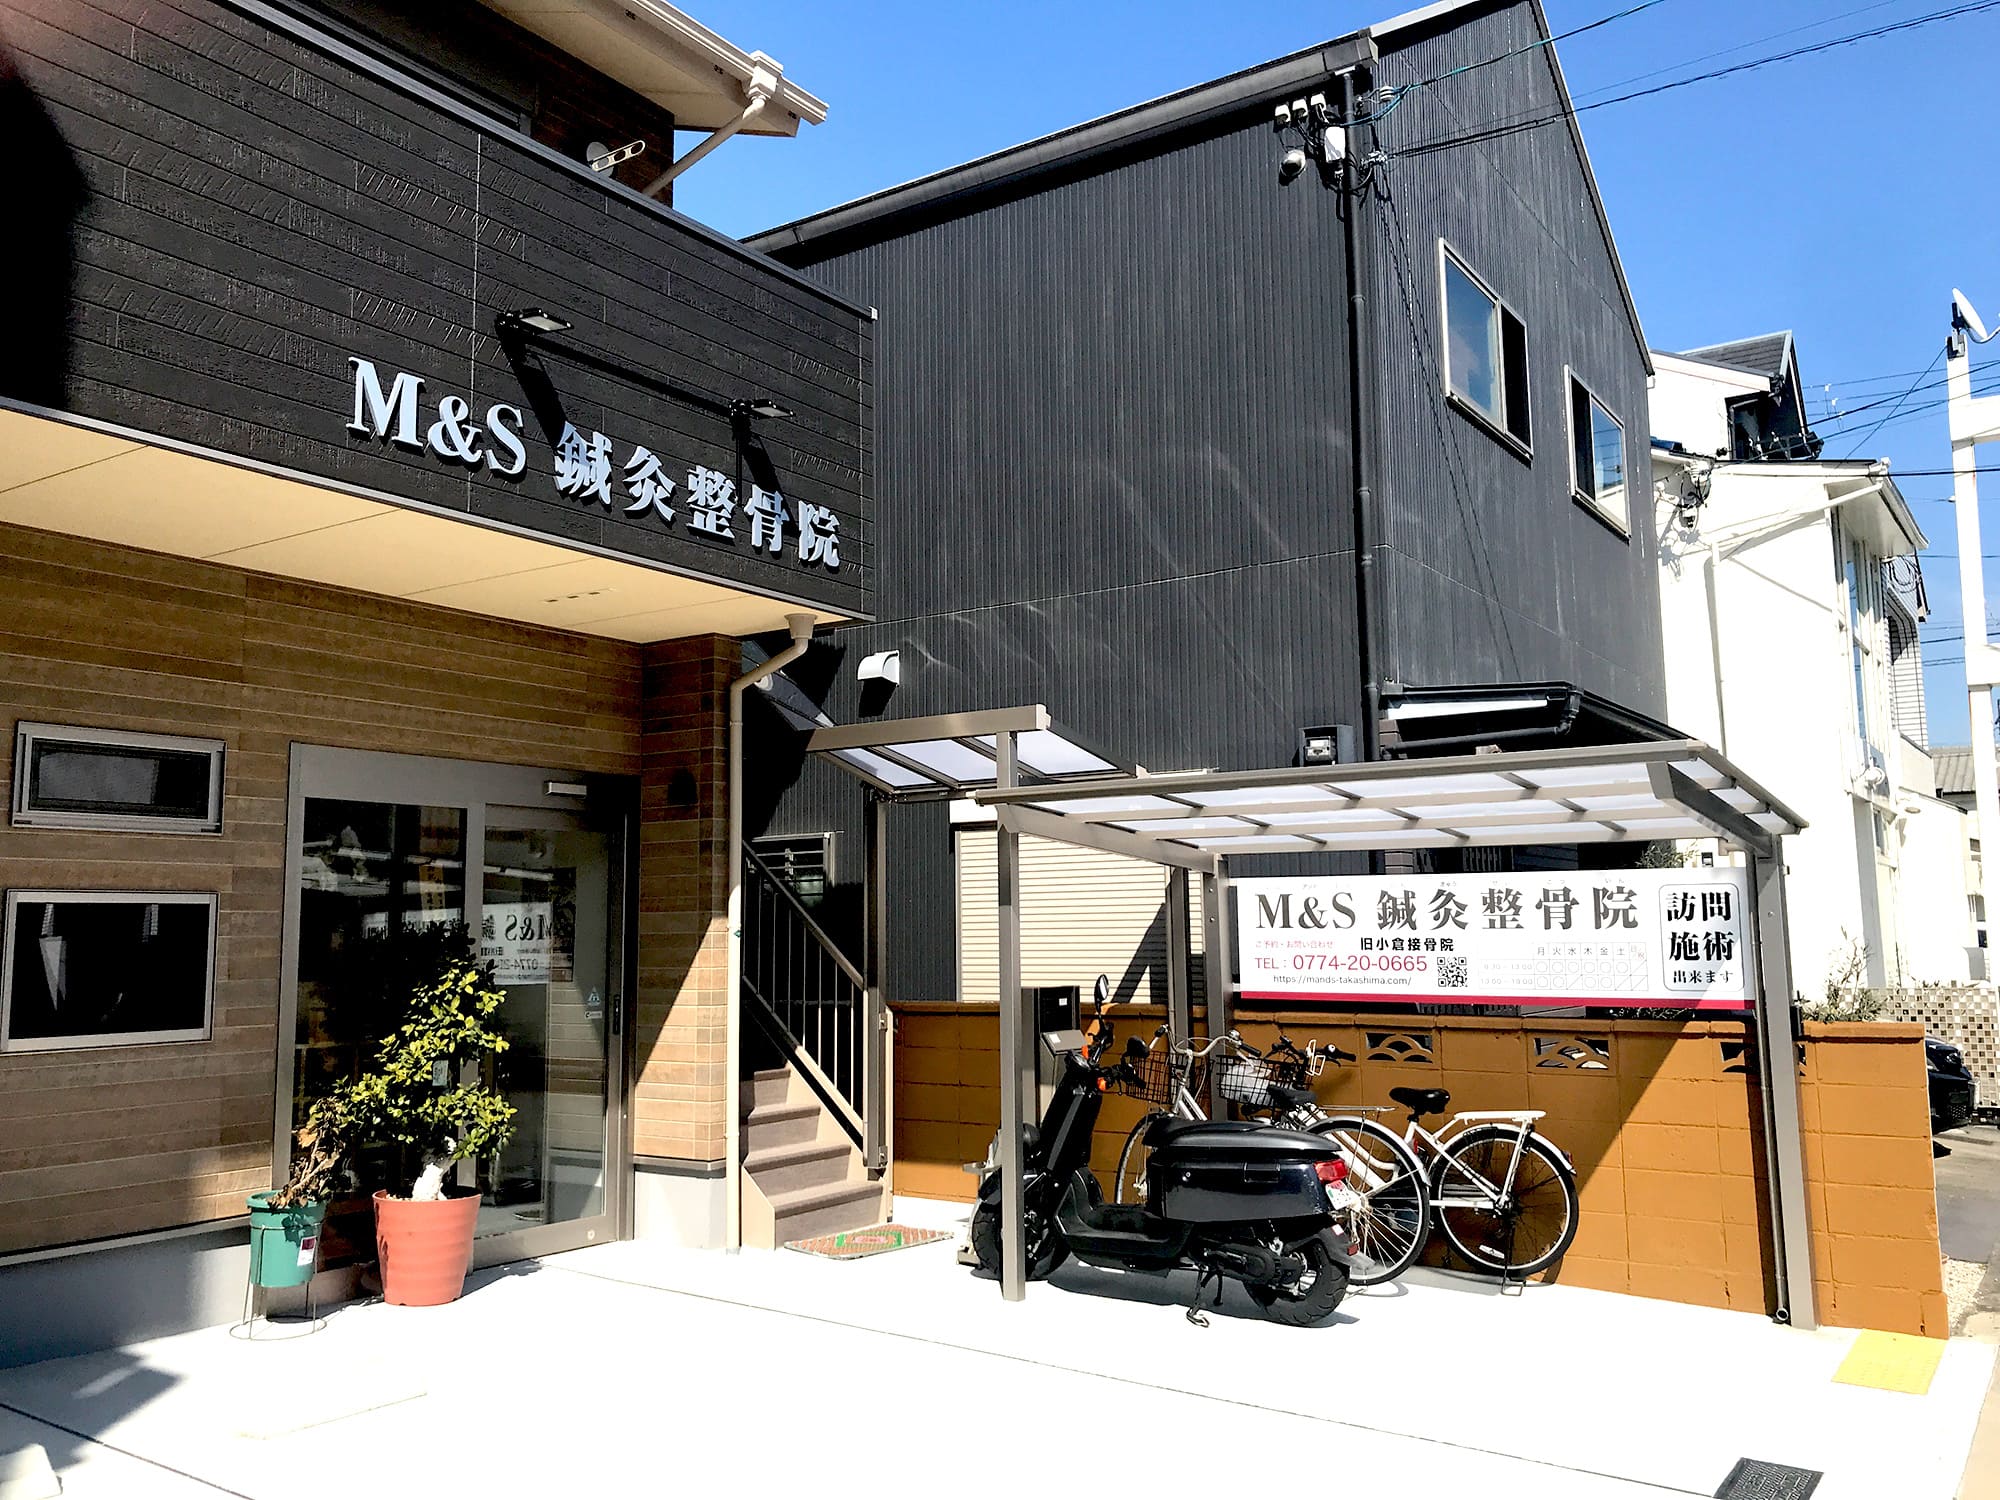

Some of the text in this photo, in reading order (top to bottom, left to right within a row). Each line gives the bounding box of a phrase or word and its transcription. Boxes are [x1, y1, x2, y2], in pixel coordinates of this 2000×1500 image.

[346, 357, 841, 567] M&S 鍼灸整骨院
[1255, 885, 1639, 931] M&S 鍼灸整骨院
[1666, 892, 1732, 921] 訪問
[1360, 937, 1454, 951] 旧小倉接骨院
[1668, 931, 1735, 961] 施術
[1293, 954, 1428, 972] 0774-20-0665
[1273, 975, 1412, 987] https://mands-takashima.com/
[1673, 969, 1733, 983] 出来ます
